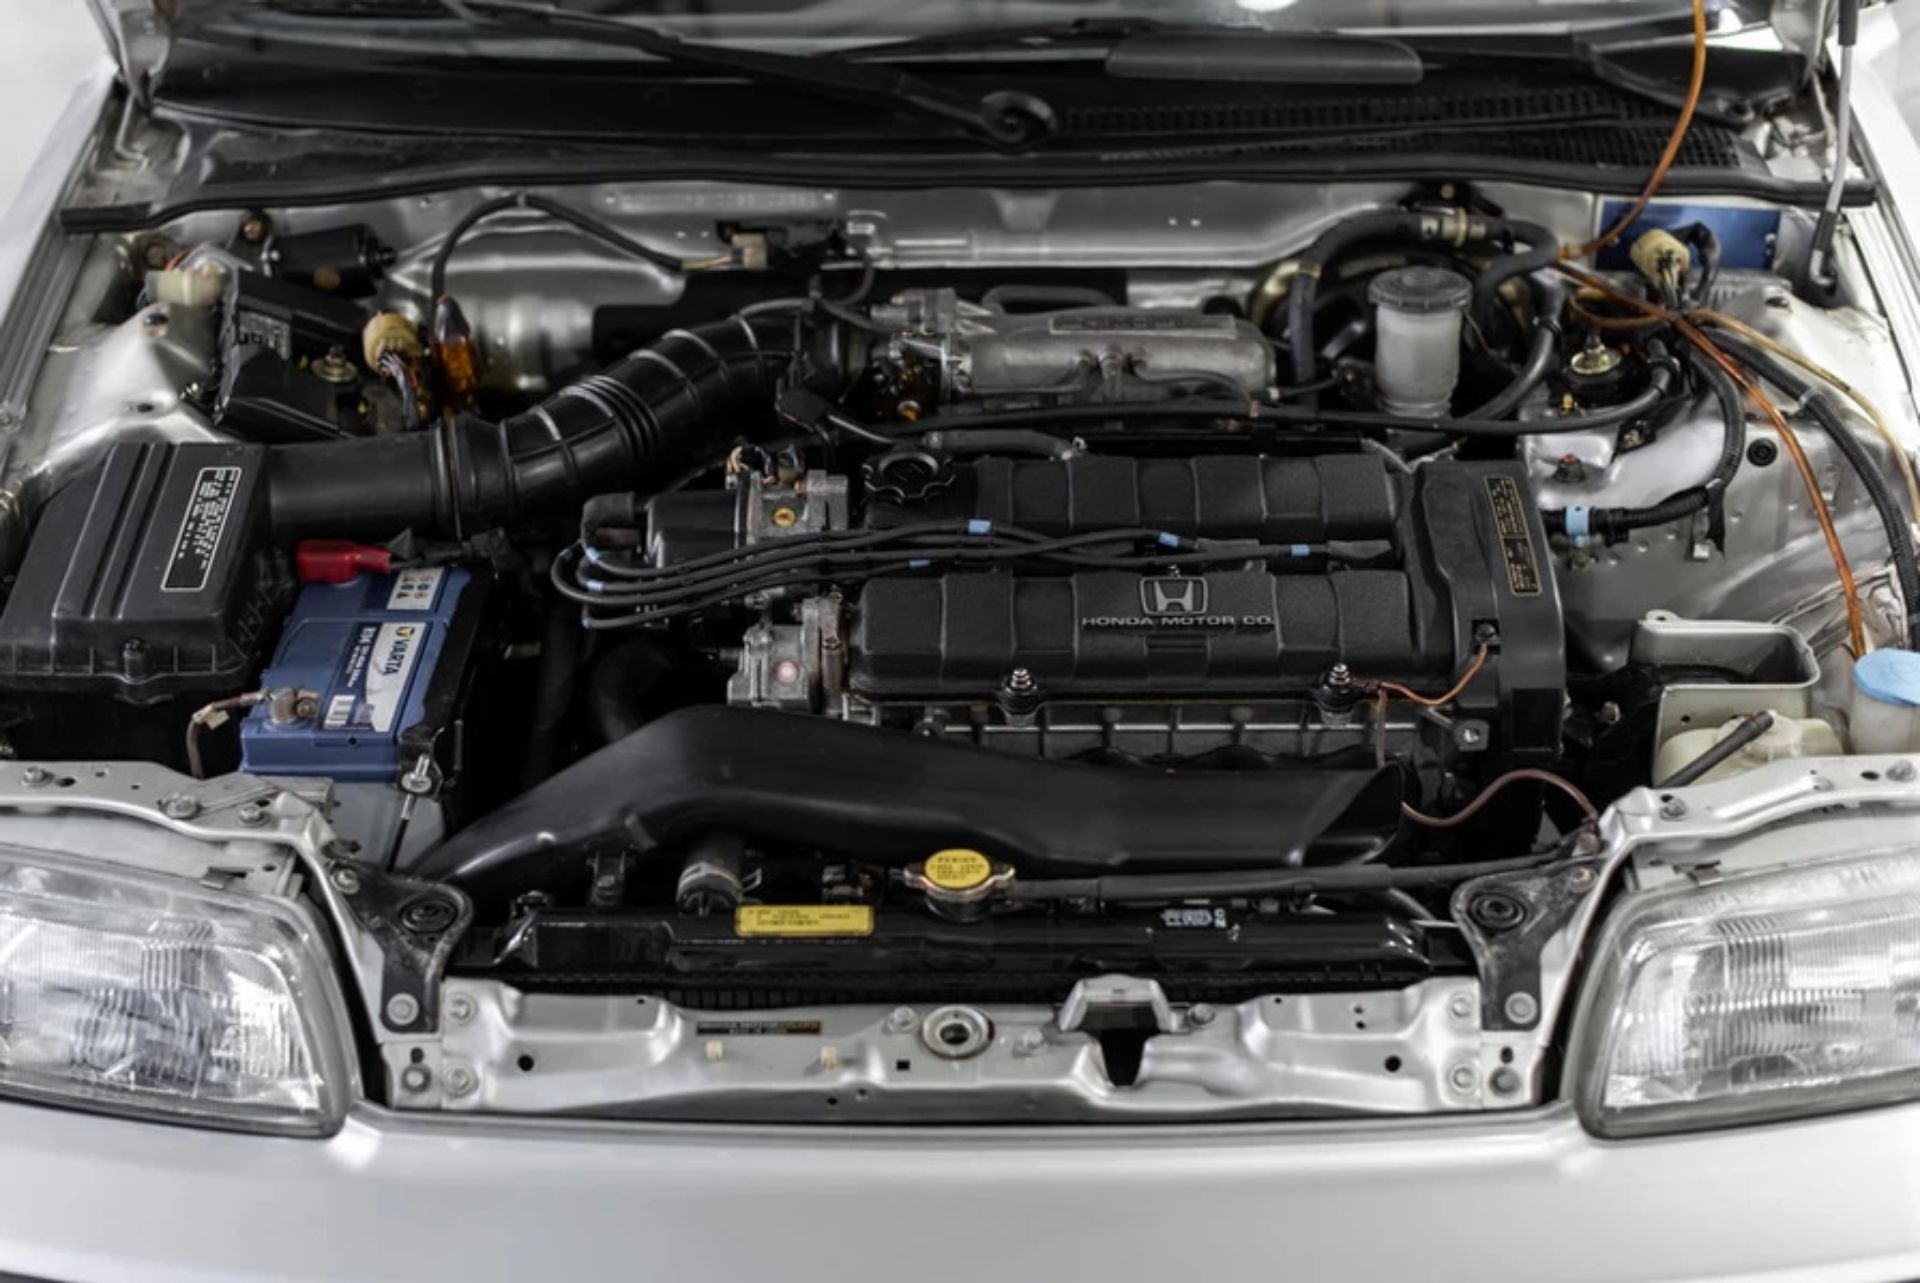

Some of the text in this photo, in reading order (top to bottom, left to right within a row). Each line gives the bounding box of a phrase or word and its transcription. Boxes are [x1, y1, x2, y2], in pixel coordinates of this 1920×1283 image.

[1081, 616, 1153, 626] HONDA
[1161, 615, 1235, 626] MOTOR
[382, 638, 412, 676] VARTA
